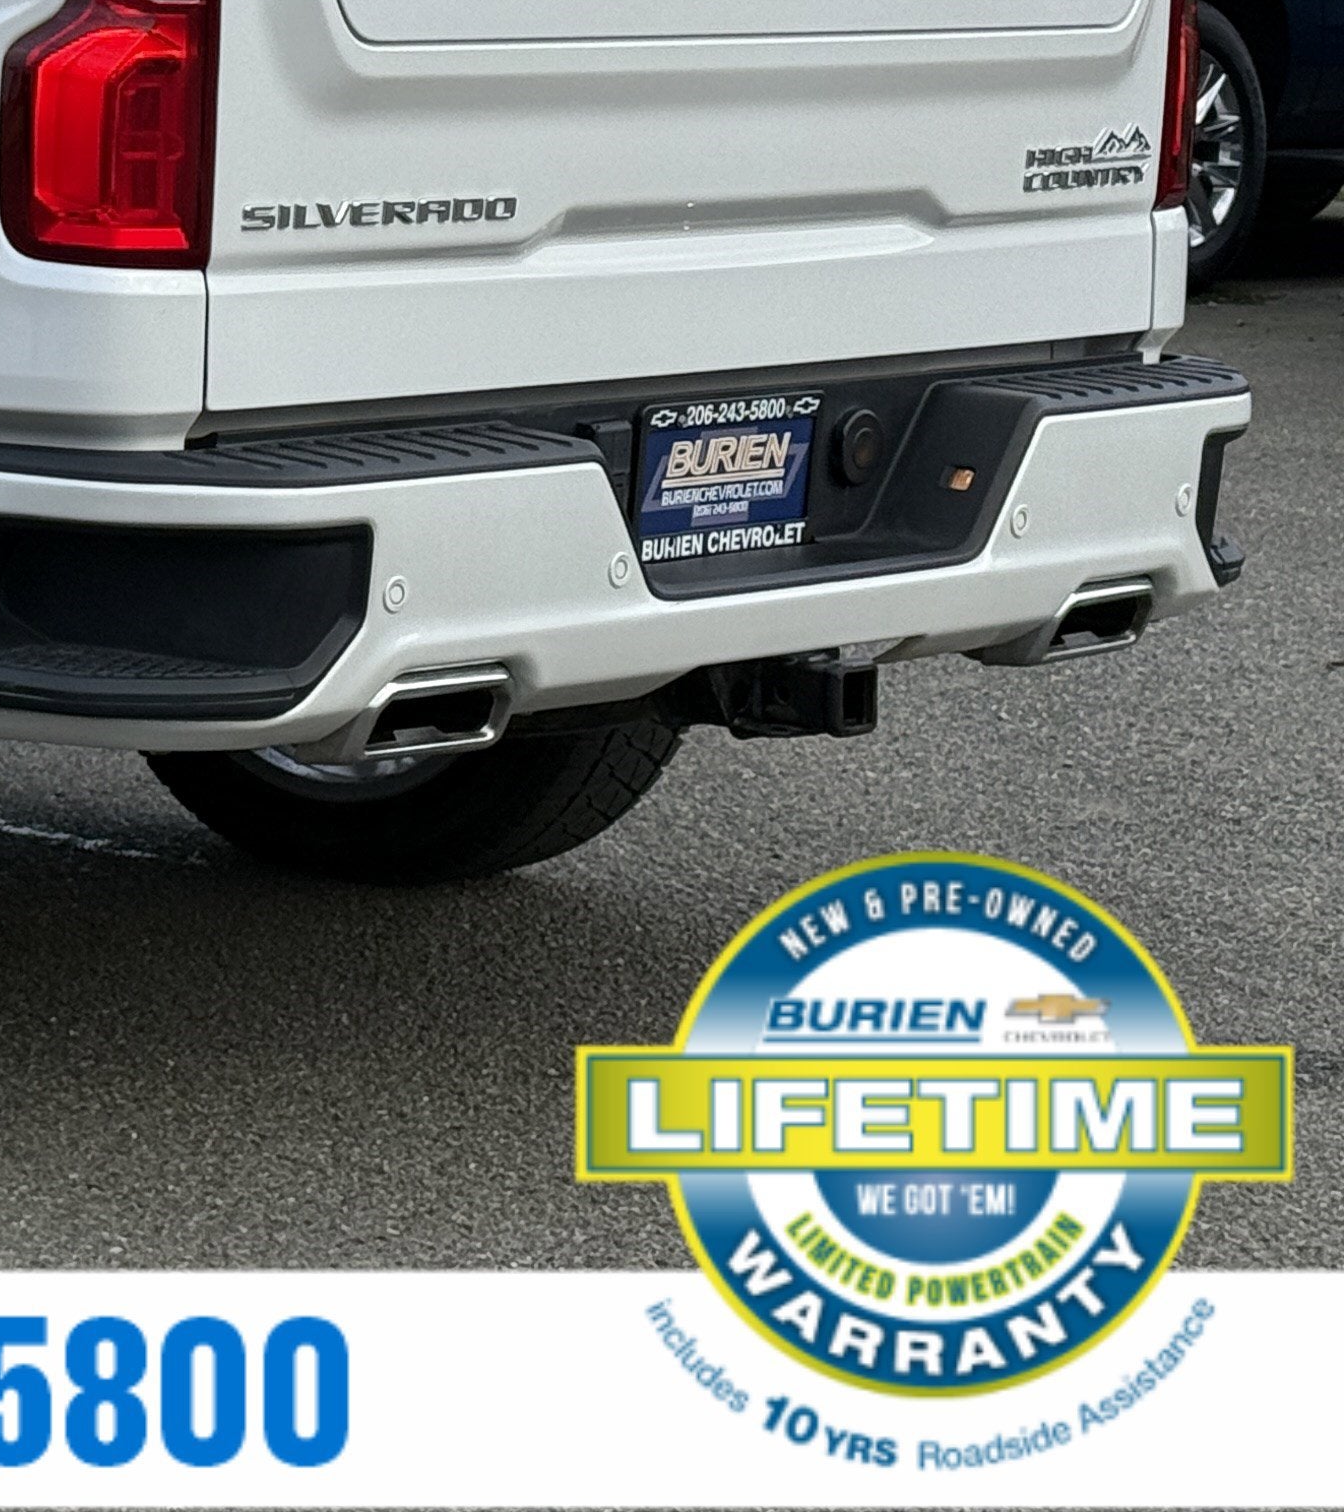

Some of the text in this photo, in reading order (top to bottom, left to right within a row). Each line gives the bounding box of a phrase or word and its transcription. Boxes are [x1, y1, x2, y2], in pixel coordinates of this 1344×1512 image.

[1025, 146, 1094, 169] HIGH
[1023, 165, 1148, 193] COUNTRY
[241, 197, 517, 231] SILVERADO
[687, 398, 785, 426] 206-243-5800
[666, 432, 791, 478] BURIEN
[642, 522, 806, 562] BURIEN CHEVROLET
